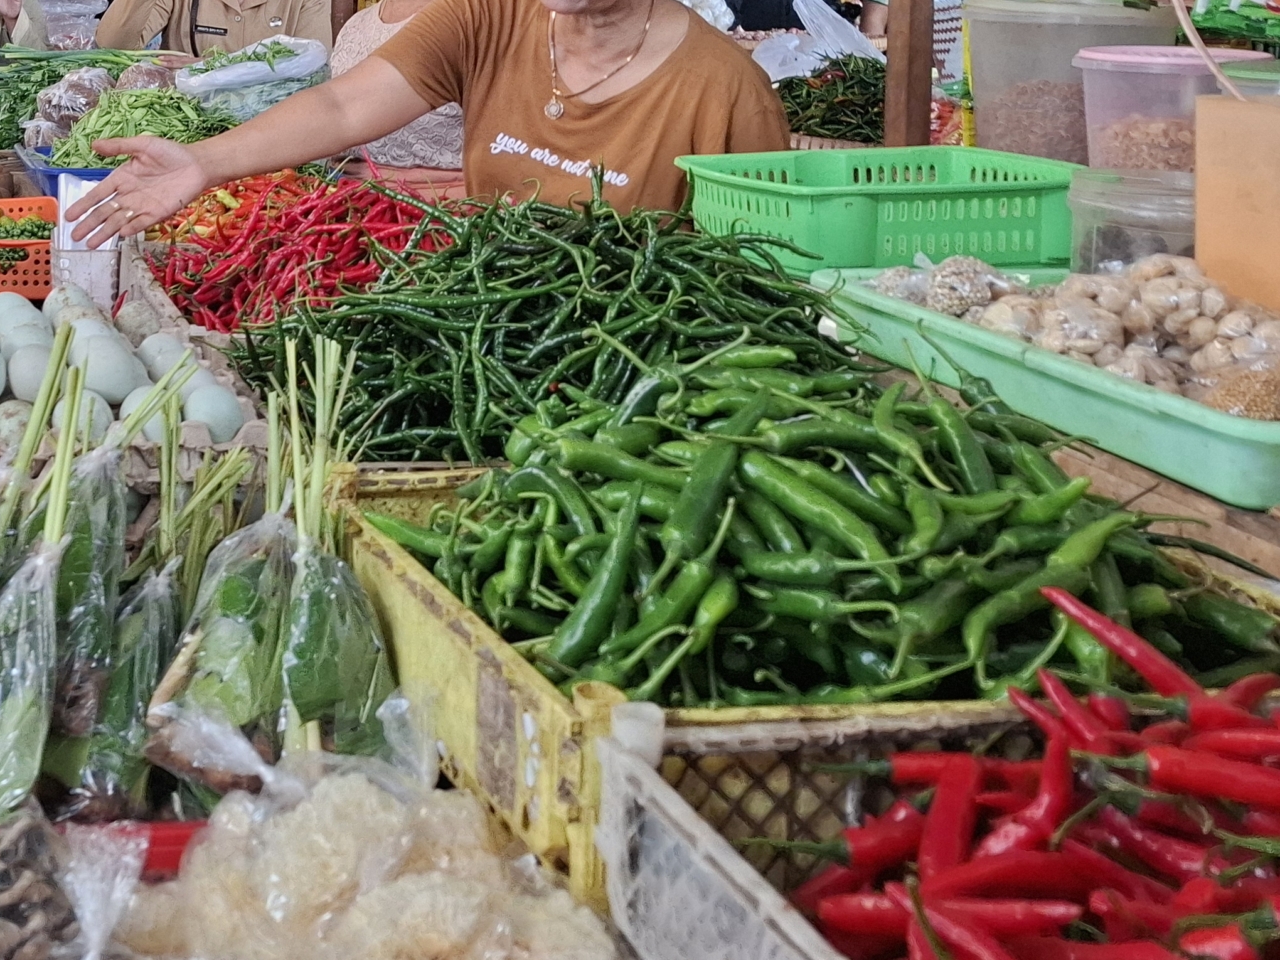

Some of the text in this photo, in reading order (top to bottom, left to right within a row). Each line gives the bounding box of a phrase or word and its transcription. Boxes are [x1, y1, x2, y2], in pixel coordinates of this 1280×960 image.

[490, 132, 529, 155] you
[530, 147, 560, 167] are
[561, 159, 591, 177] not
